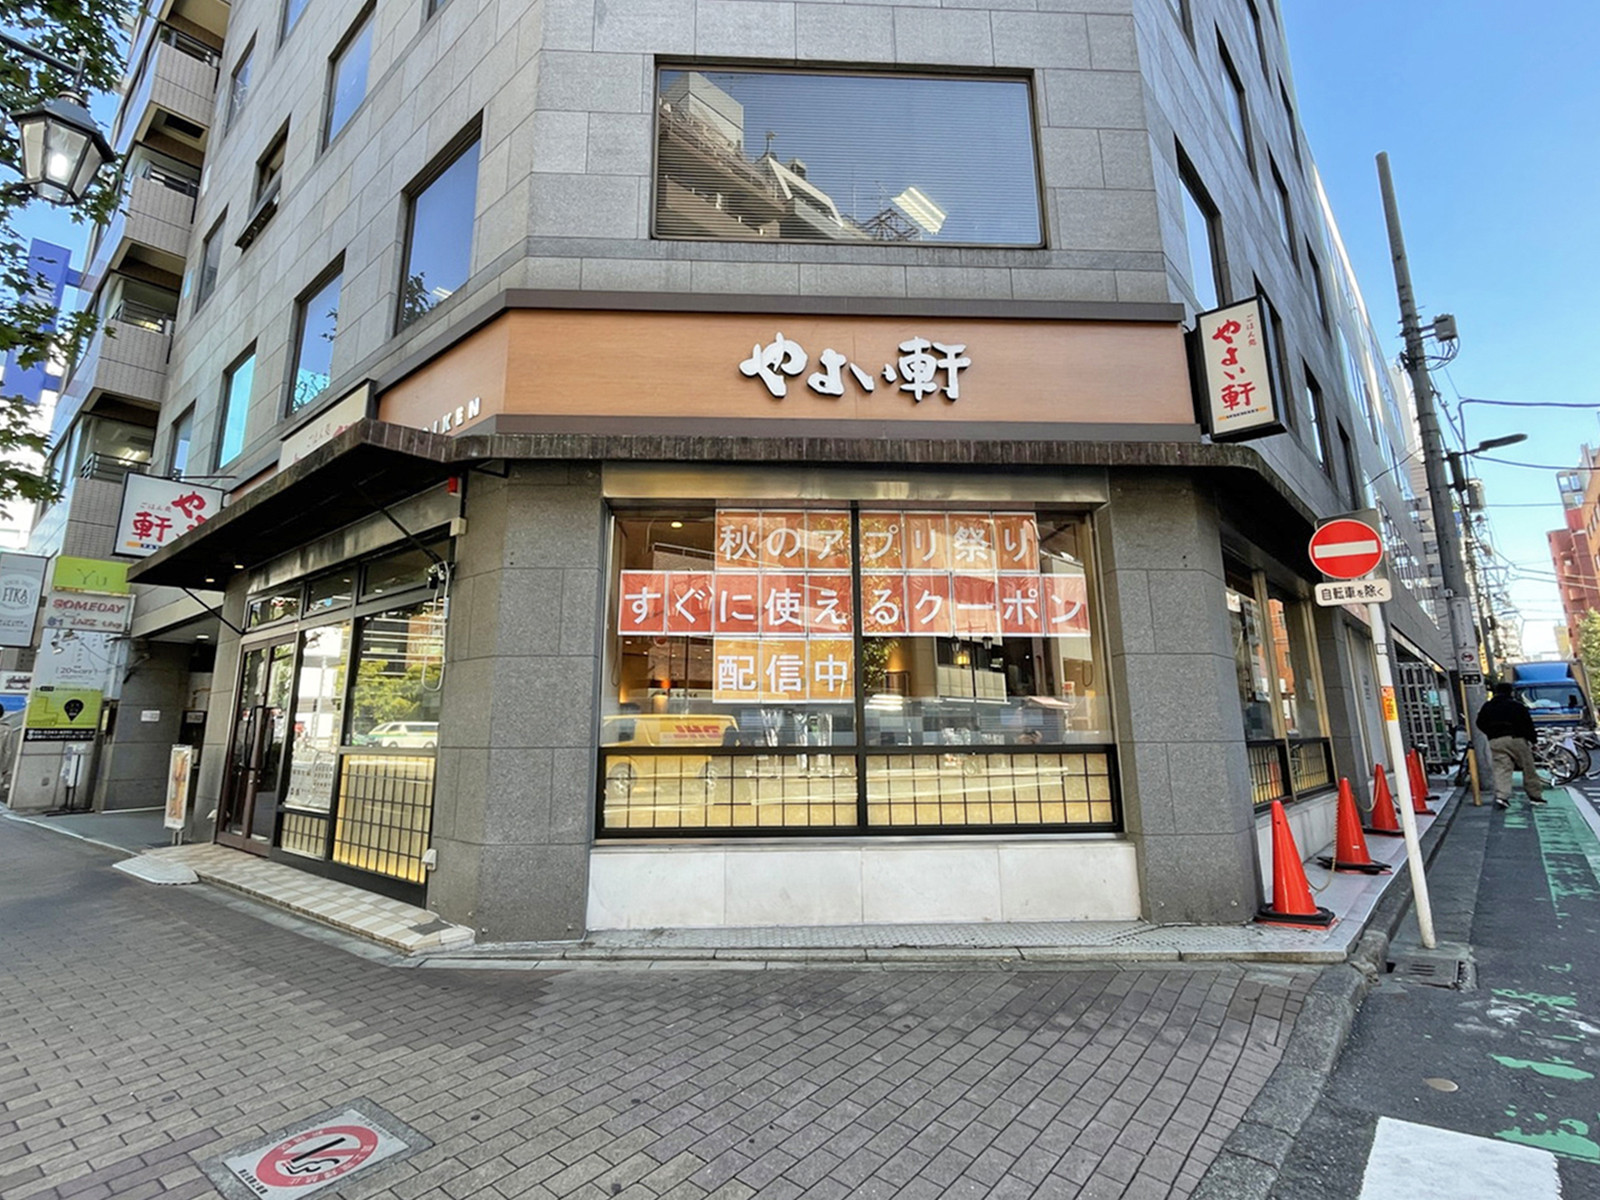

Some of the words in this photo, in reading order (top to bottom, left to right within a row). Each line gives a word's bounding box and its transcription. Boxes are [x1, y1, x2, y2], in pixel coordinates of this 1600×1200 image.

[739, 331, 972, 402] やよい軒
[1212, 319, 1256, 411] やよい軒
[422, 396, 481, 434] IKEN
[719, 524, 1029, 563] 秋のアプリ祭り
[53, 599, 125, 614] SOMEDAY
[624, 587, 1083, 626] すぐに使えるクーポン
[1321, 584, 1384, 601] 自転車を除く
[717, 653, 848, 693] 配信中
